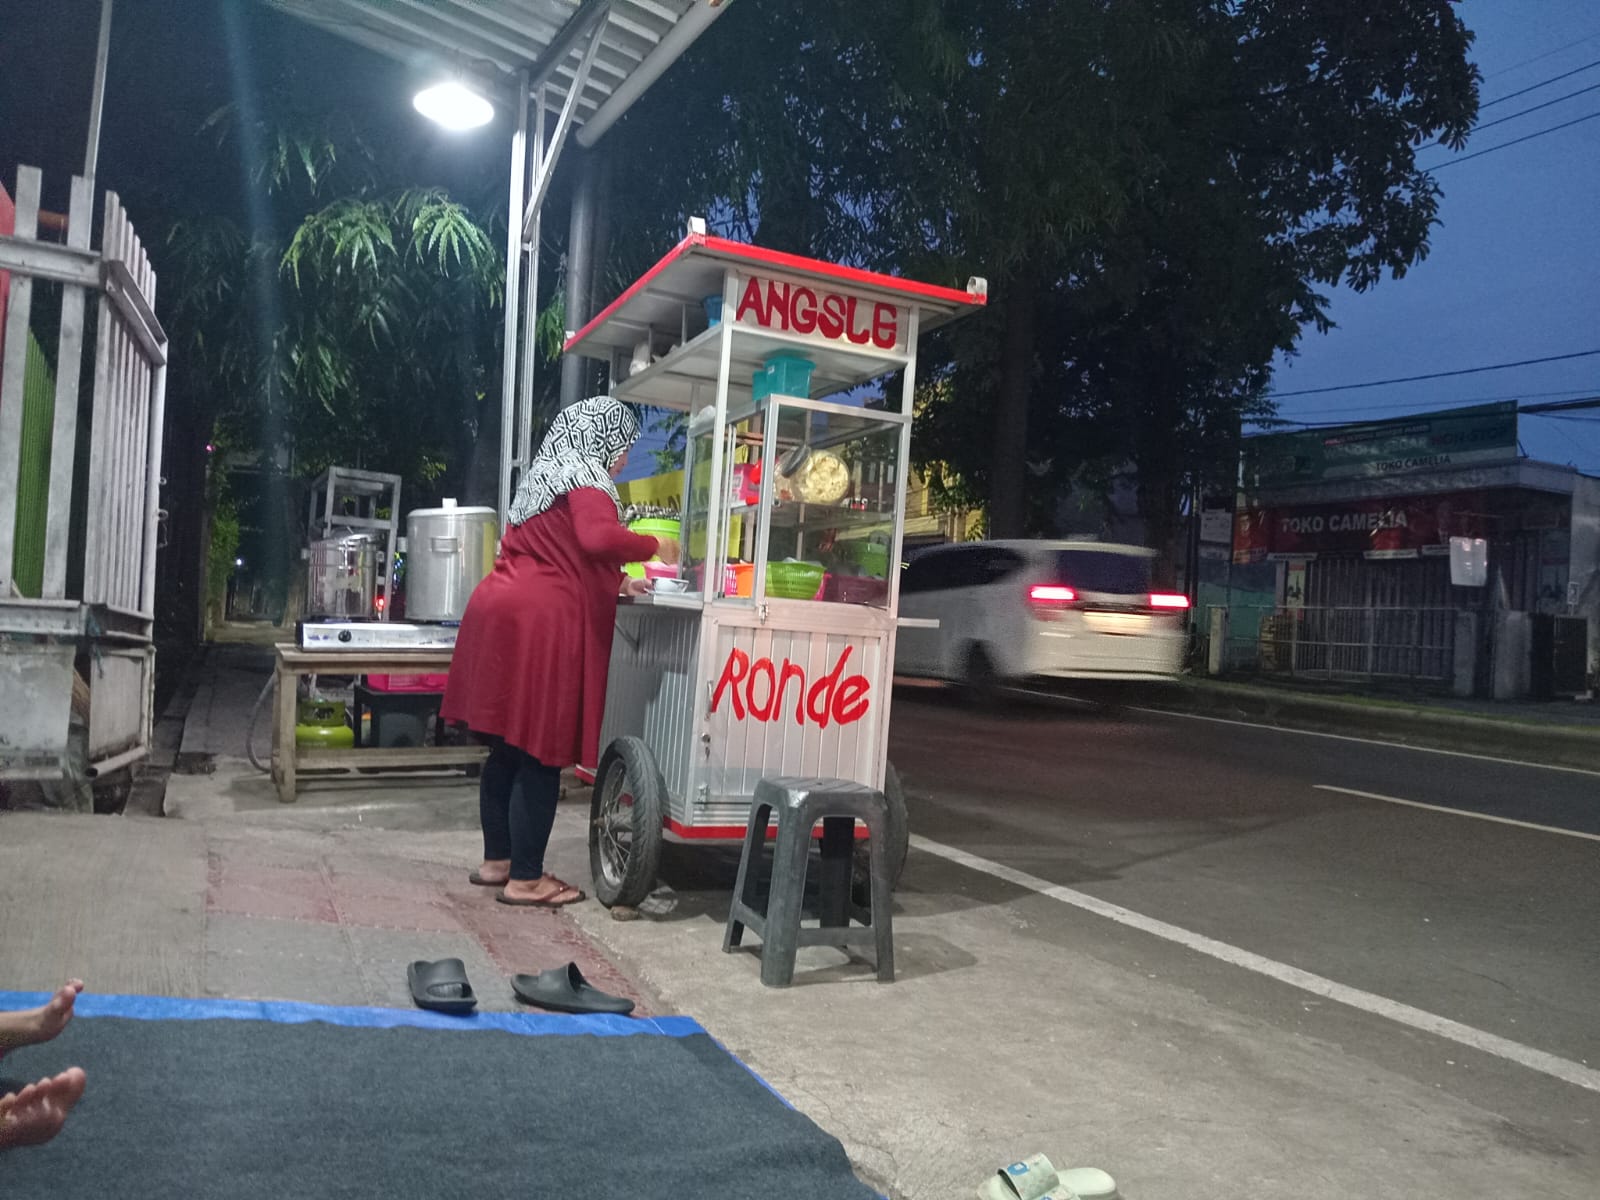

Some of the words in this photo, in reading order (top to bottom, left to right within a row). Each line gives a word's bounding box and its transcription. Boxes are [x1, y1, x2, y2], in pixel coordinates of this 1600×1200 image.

[736, 276, 898, 349] ANGSLE
[1376, 461, 1402, 472] TOKO
[1404, 455, 1450, 470] CAMELIA
[1282, 516, 1324, 533] TOKO
[1328, 510, 1408, 533] CAMELIA
[711, 646, 871, 729] Ronde
